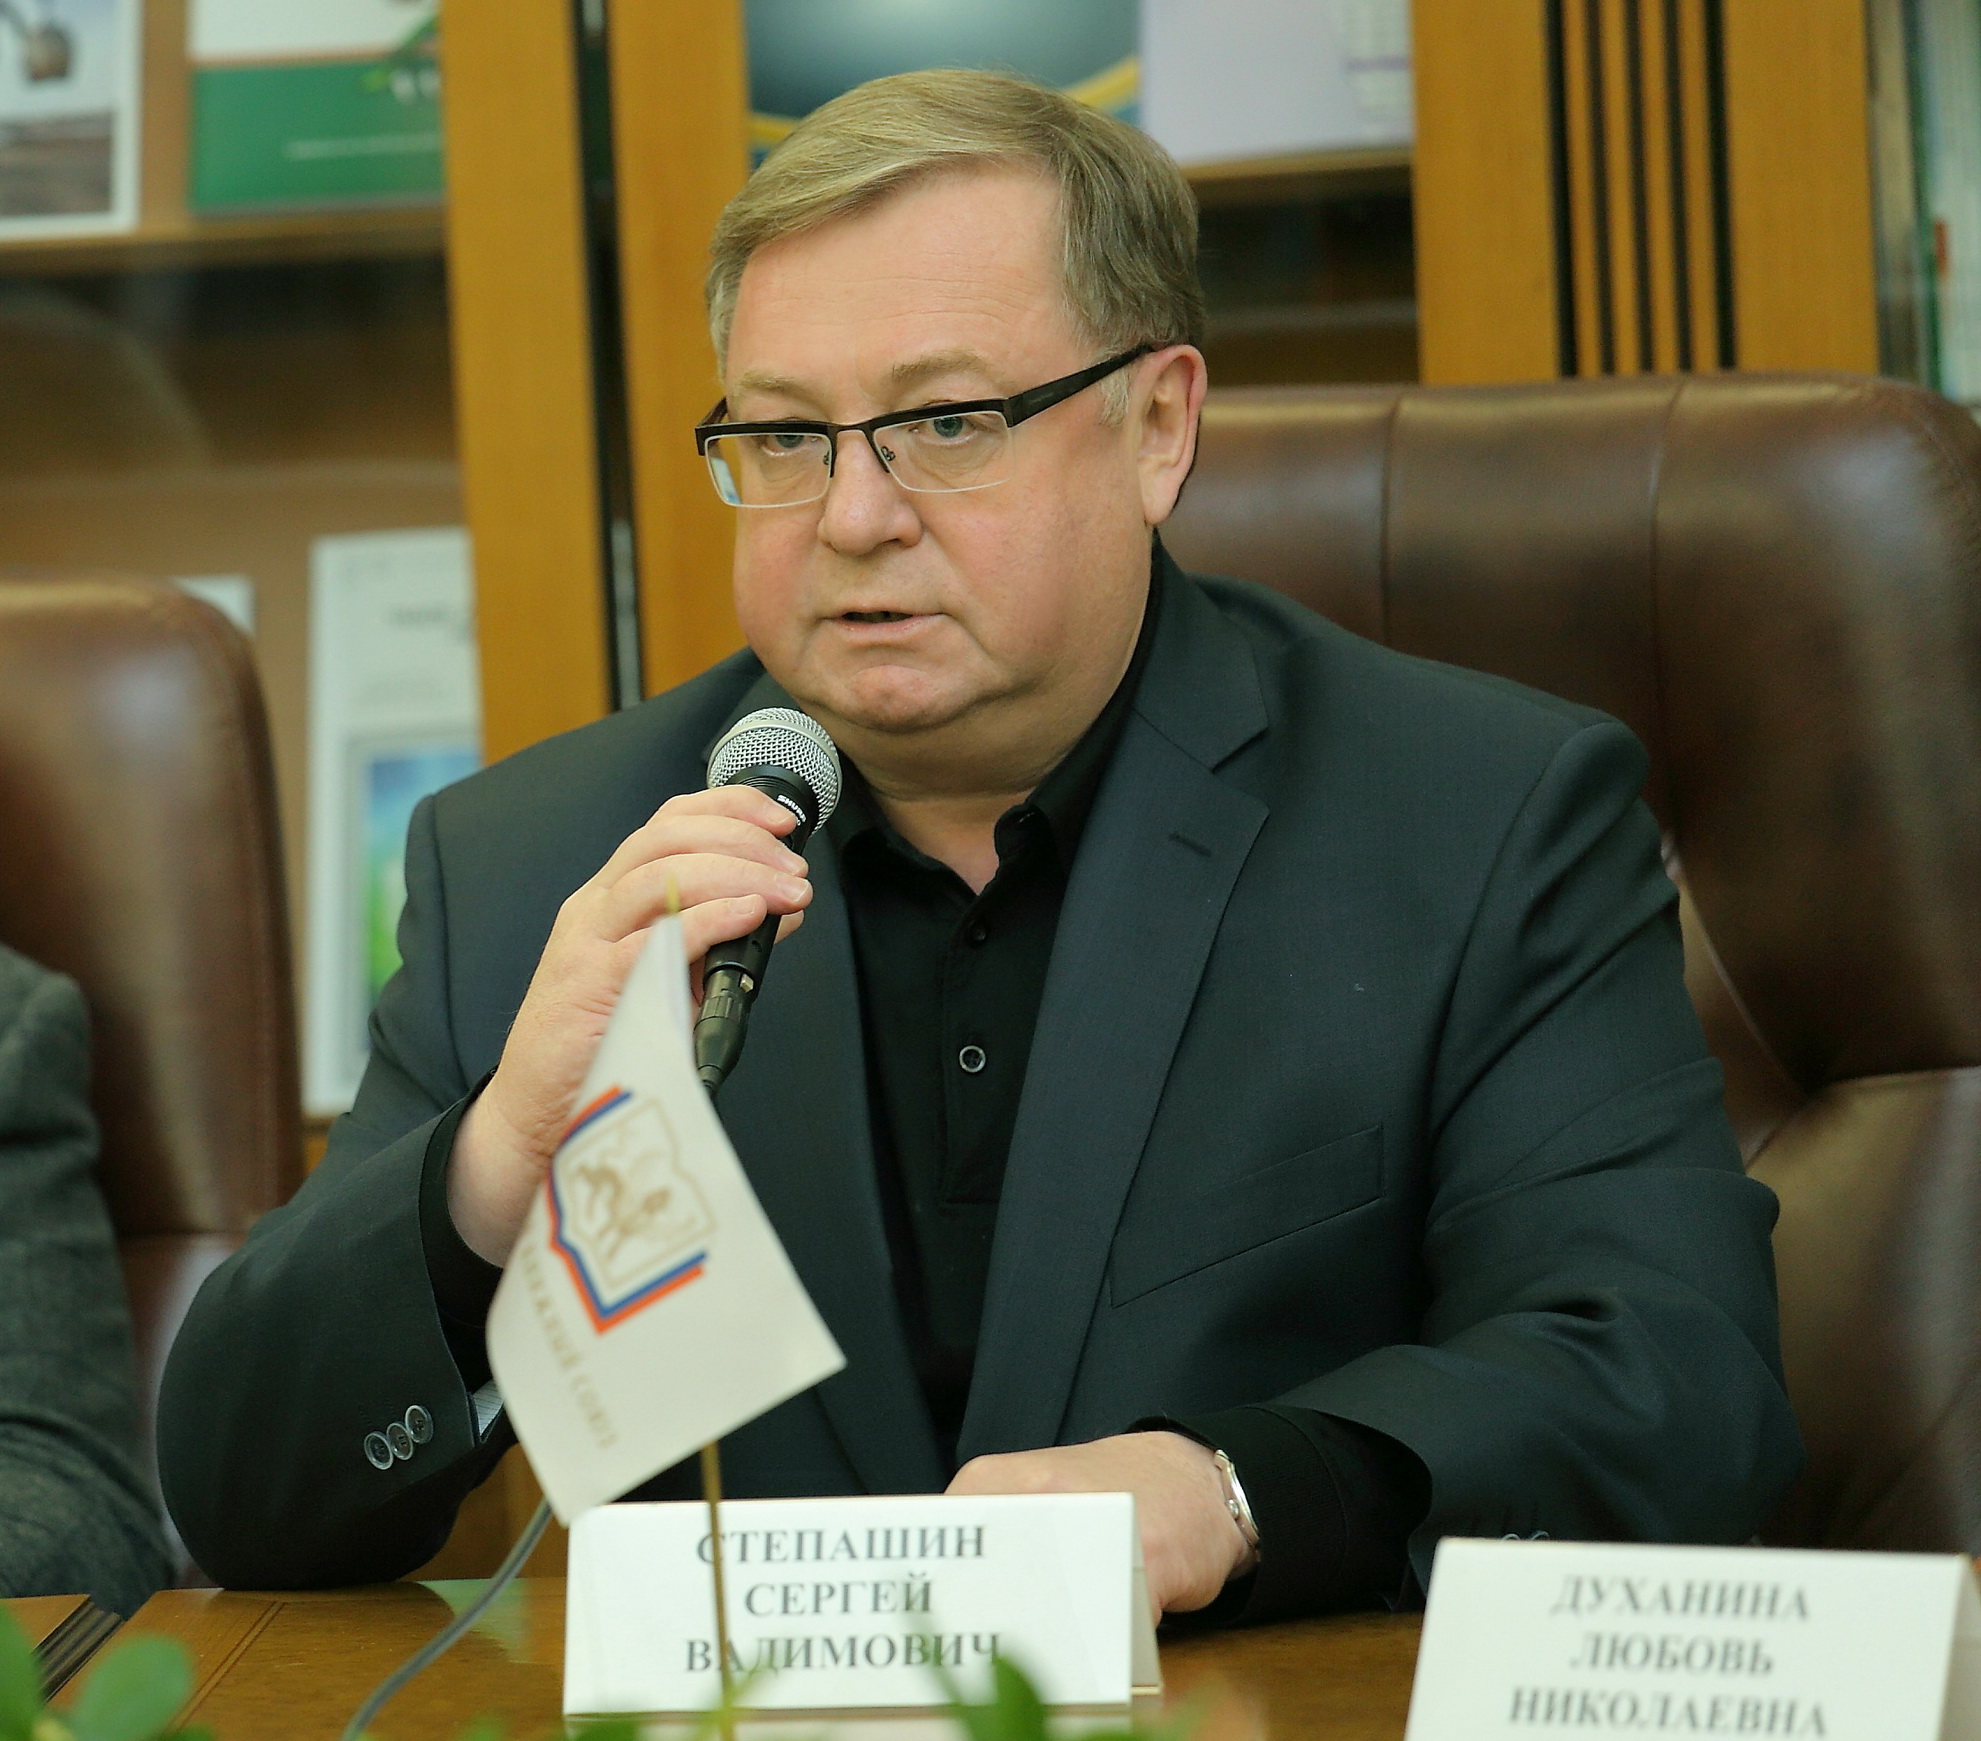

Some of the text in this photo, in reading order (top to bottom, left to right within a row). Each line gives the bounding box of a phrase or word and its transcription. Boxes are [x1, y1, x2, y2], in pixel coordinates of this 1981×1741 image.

[778, 796, 806, 822] SHURE
[697, 1527, 986, 1562] СТЕПАШИН
[744, 1571, 933, 1615] СЕРГЕЙ
[1552, 1575, 1808, 1620] ДУХАНИНА
[685, 1634, 1001, 1672] ВАДИМОВИЧ
[1570, 1631, 1774, 1674] ЛЮБОВЬ
[1511, 1687, 1827, 1736] НИКОЛАЕВНА
